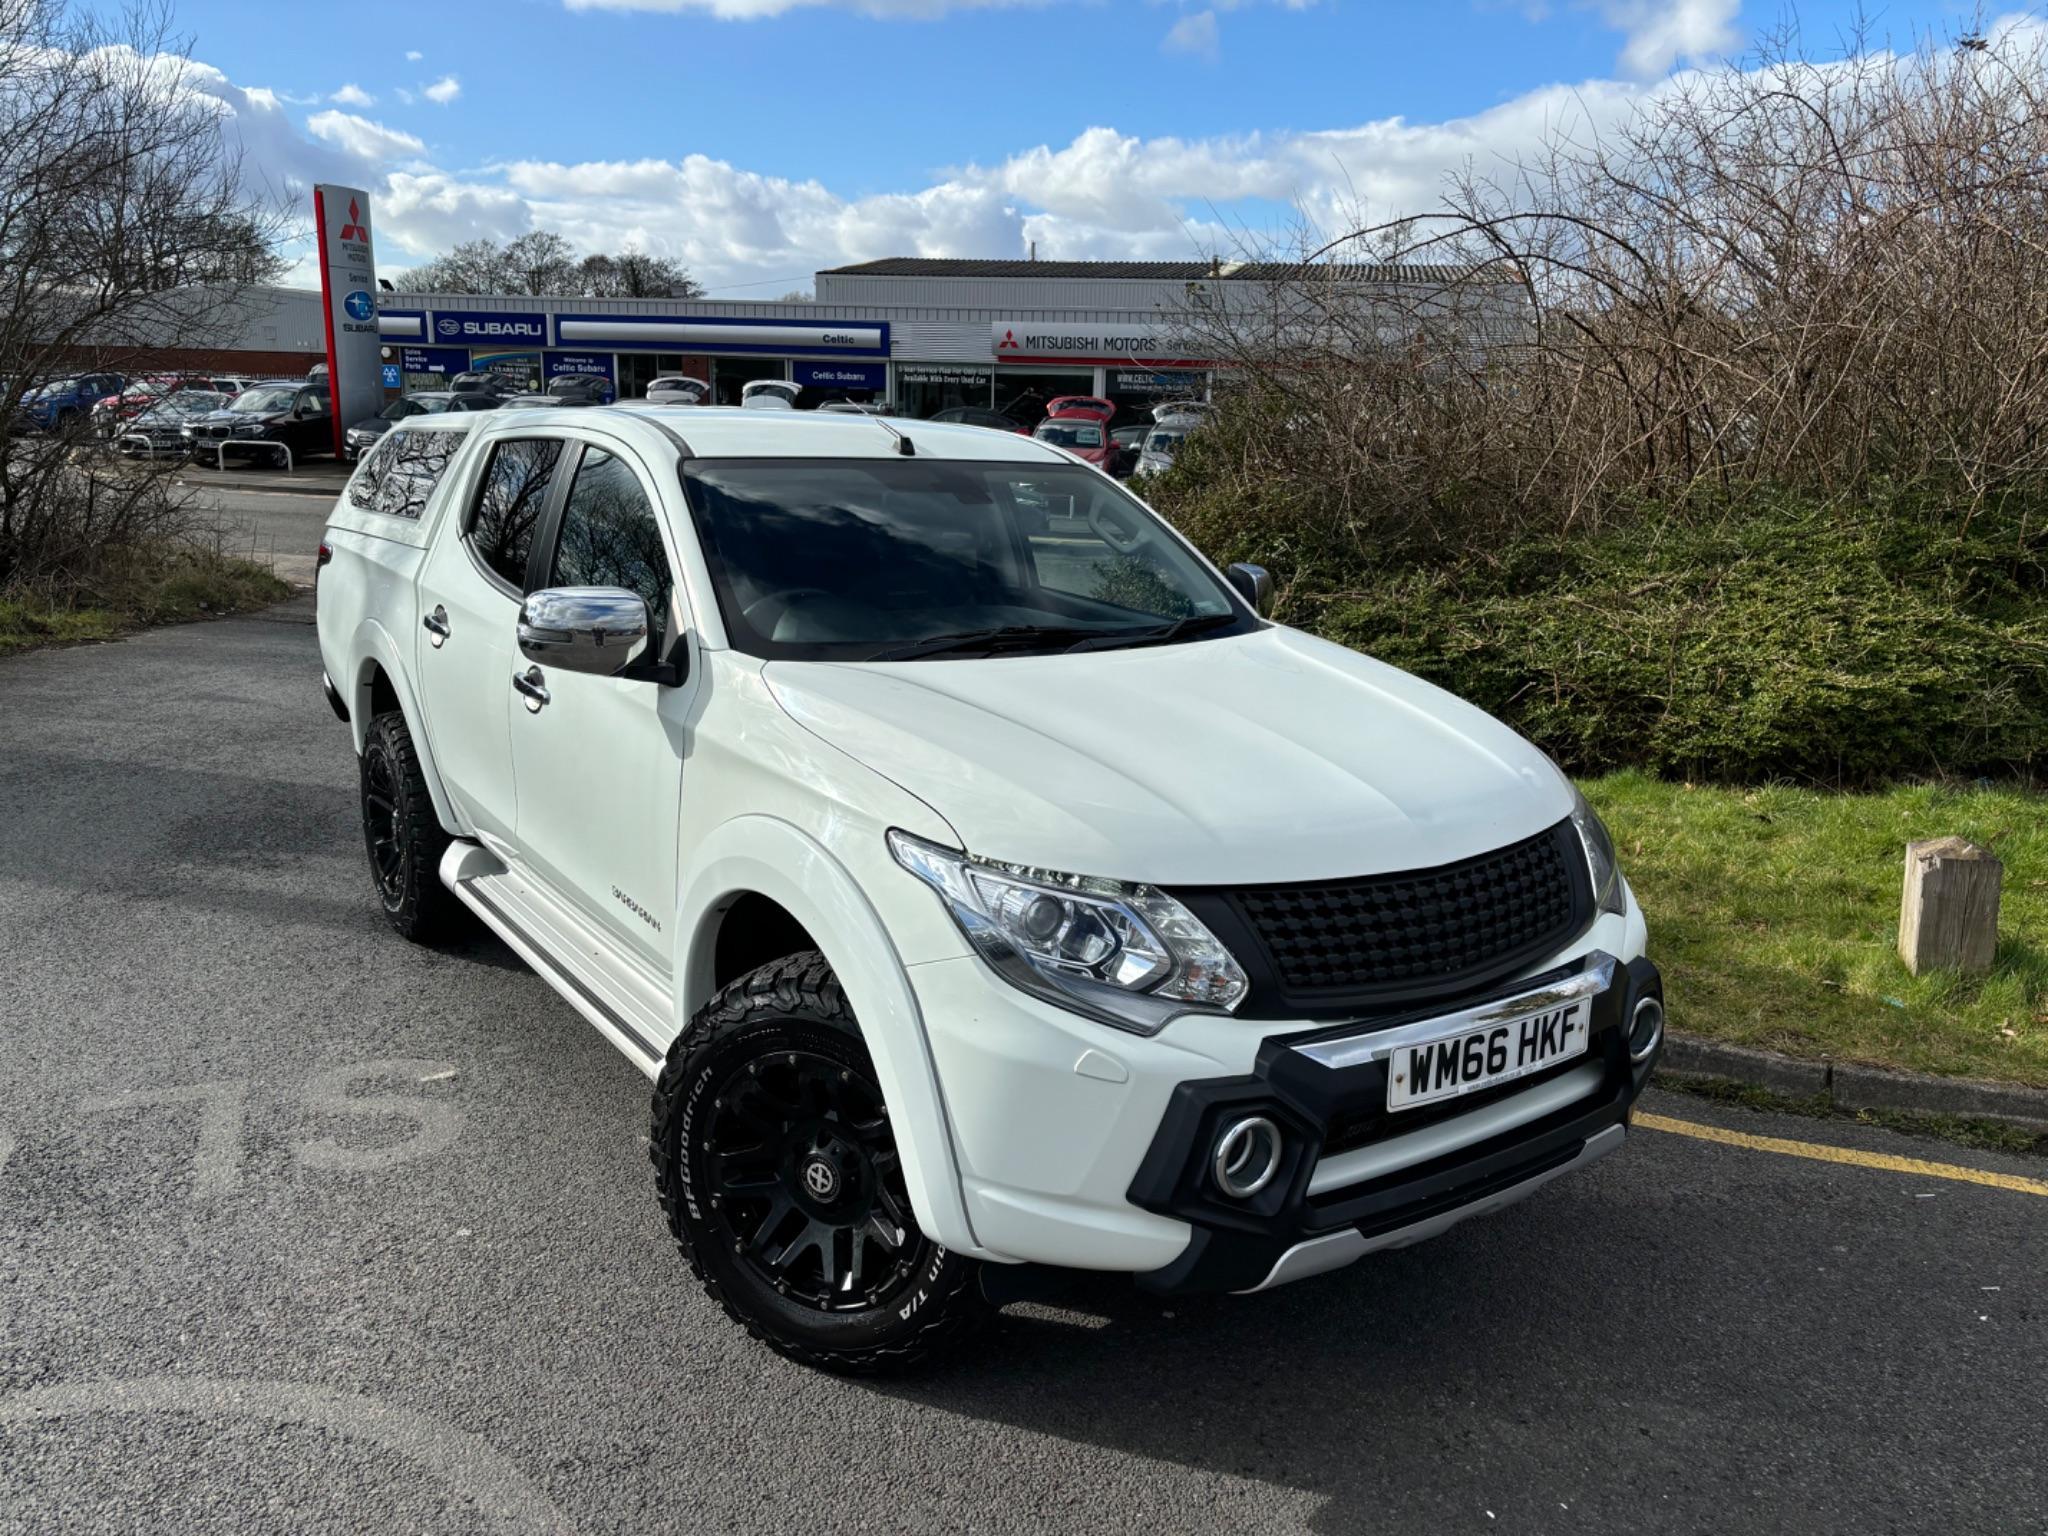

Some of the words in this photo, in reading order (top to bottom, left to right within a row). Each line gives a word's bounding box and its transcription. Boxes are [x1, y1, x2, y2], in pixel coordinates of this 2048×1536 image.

[343, 324, 377, 333] SUBARU
[464, 322, 541, 337] SUBARU
[822, 334, 854, 345] Celtic
[1026, 335, 1098, 350] MITSUBISHI
[1103, 337, 1157, 351] MOTORS
[552, 363, 576, 372] Celtic
[577, 364, 606, 373] Subaru
[812, 371, 834, 380] Celtic
[836, 372, 866, 382] Subaru
[1409, 1028, 1508, 1096] WM66
[1517, 1005, 1580, 1067] HKF
[679, 1066, 713, 1220] BFGoodrich
